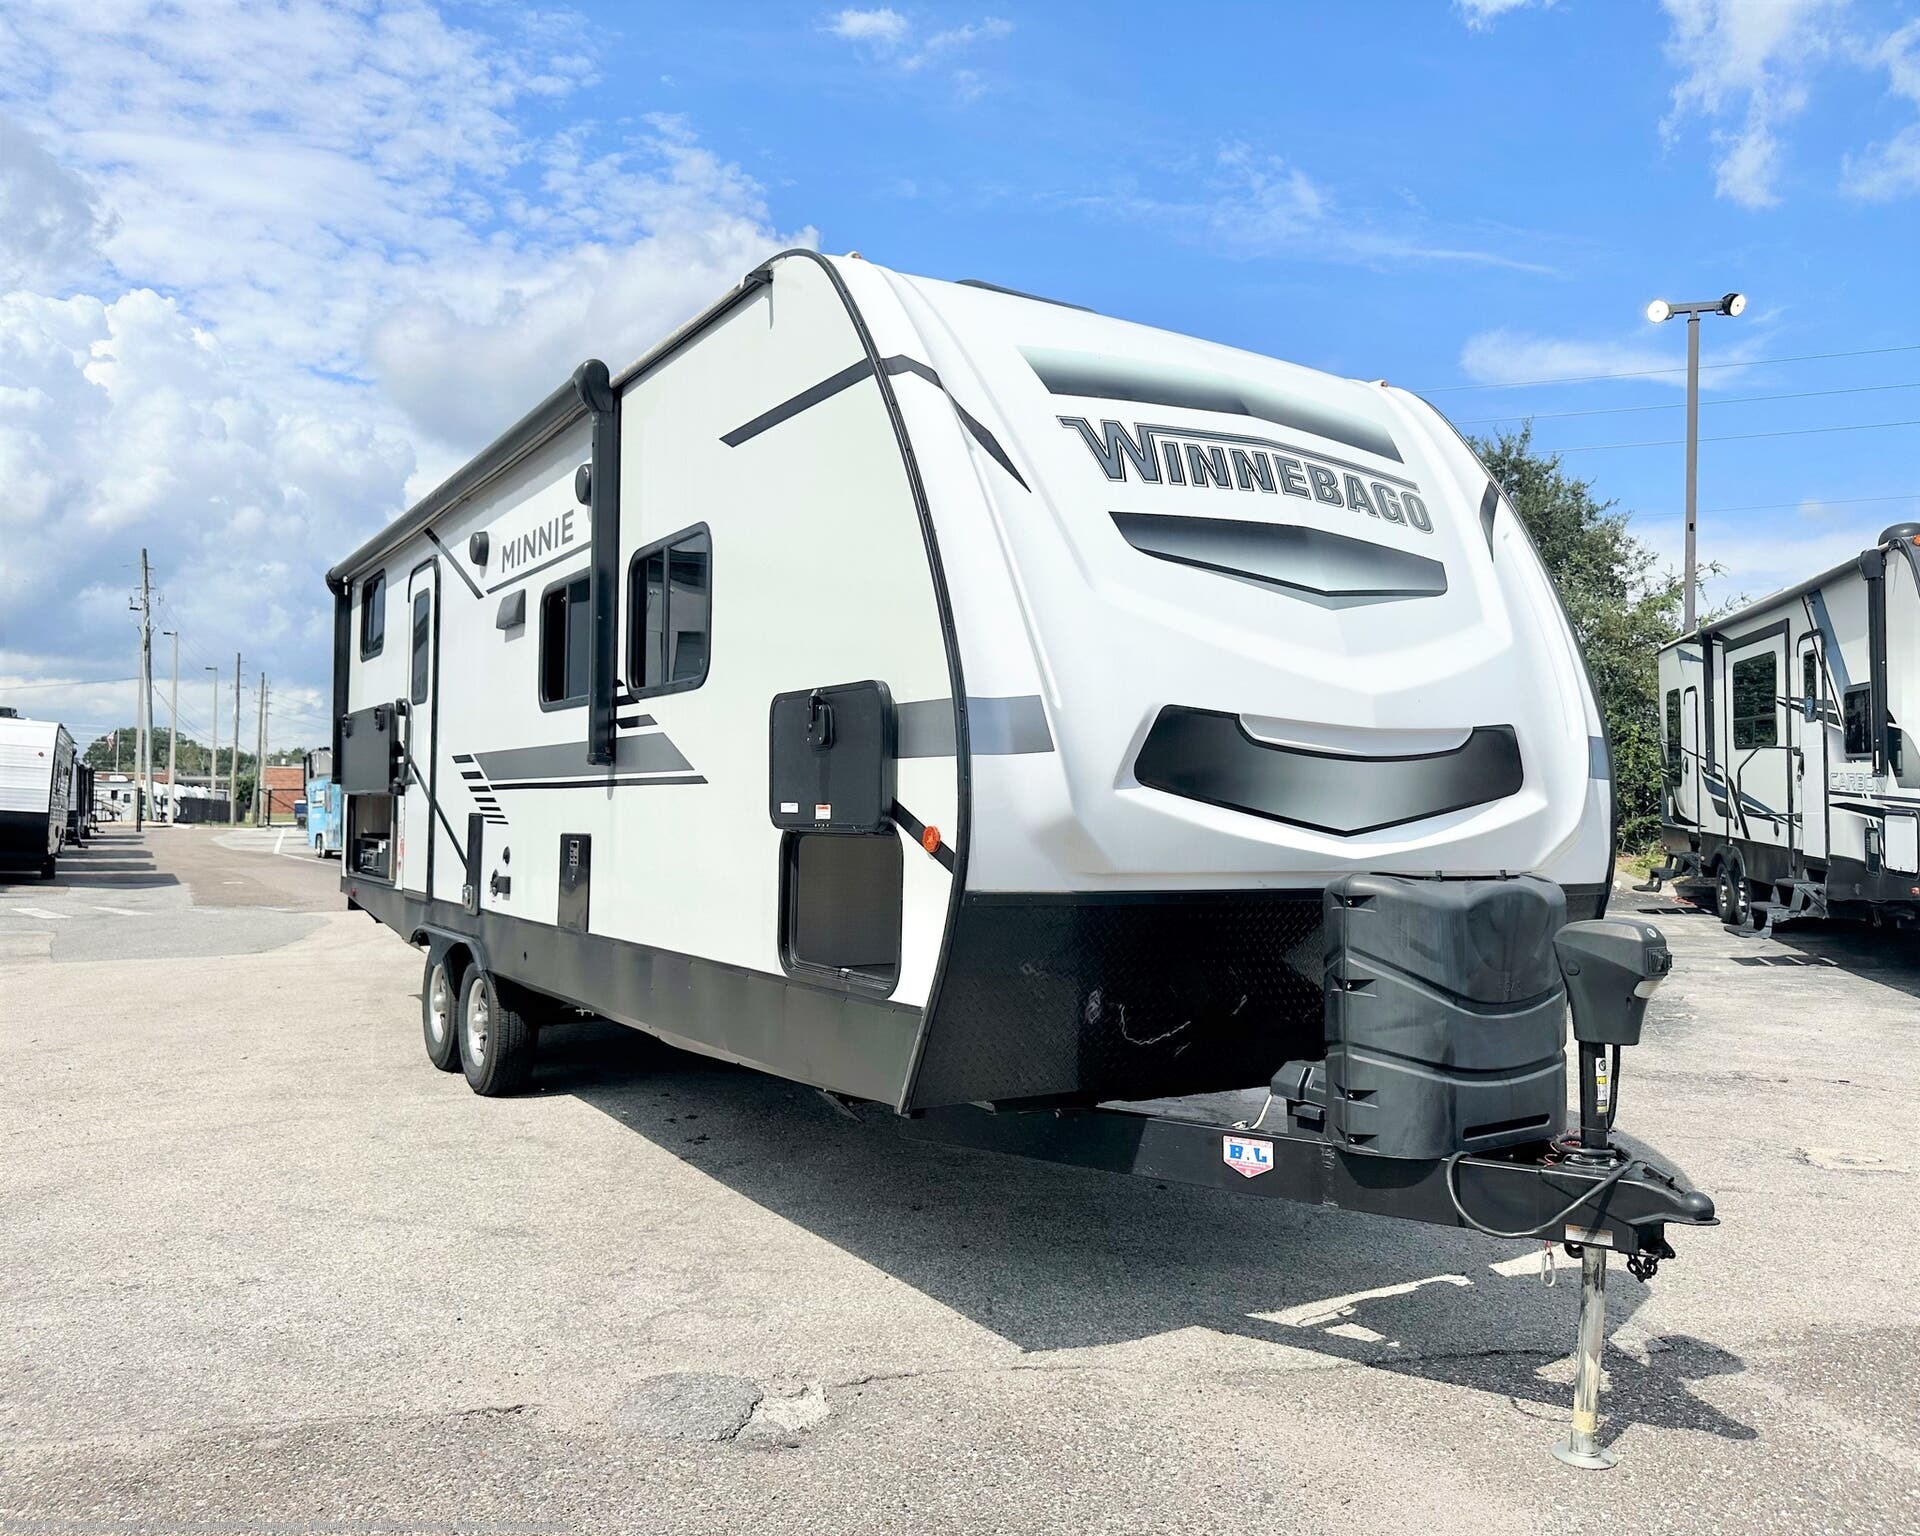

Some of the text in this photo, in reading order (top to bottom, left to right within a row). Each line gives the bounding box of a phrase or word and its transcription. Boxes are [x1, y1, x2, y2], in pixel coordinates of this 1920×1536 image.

[1056, 415, 1435, 535] WINNEBAGO
[502, 509, 574, 574] MINNIE
[1229, 1144, 1267, 1163] BL
